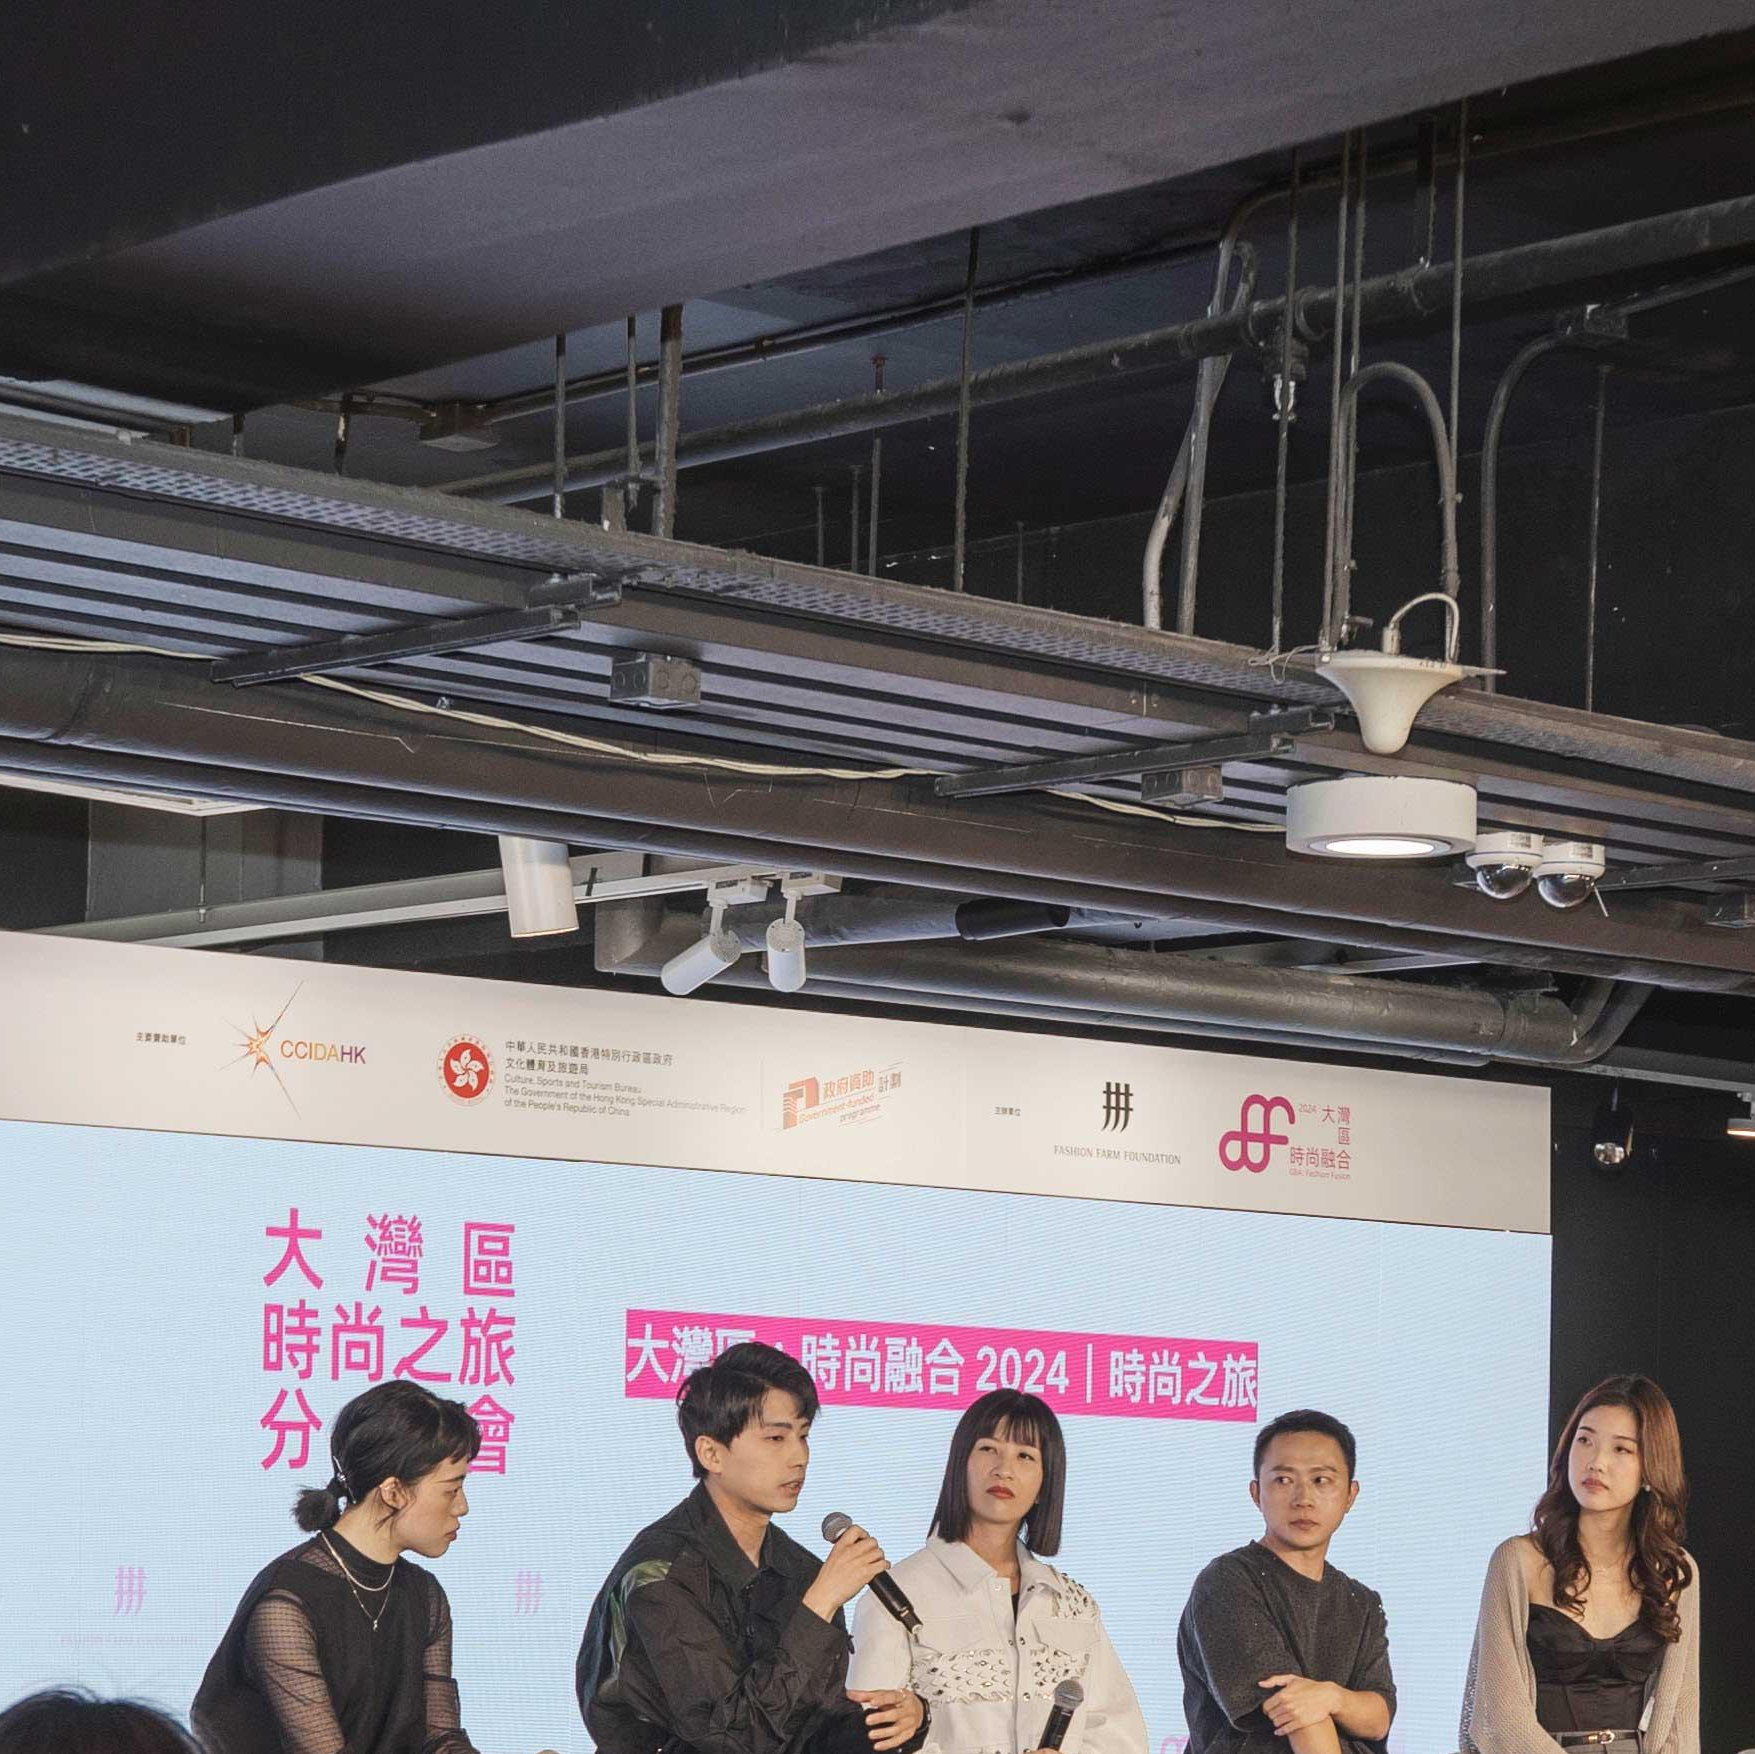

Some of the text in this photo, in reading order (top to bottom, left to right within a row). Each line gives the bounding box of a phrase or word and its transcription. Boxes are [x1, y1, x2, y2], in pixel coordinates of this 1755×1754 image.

[280, 1039, 366, 1064] CCIDAHK
[505, 1040, 673, 1066] 中華人民共和國香港特別行政區政府
[505, 1058, 589, 1076] 文化體育及旅遊局
[537, 1076, 563, 1089] Sports
[565, 1079, 580, 1088] and
[582, 1080, 613, 1091] Tourism
[823, 1069, 875, 1100] 政府資助
[504, 1098, 630, 1117] of the People's Republic of China
[505, 1086, 520, 1096] The
[520, 1087, 568, 1100] Government
[569, 1091, 579, 1100] of
[579, 1092, 592, 1102] the
[593, 1094, 615, 1106] Hong
[616, 1096, 636, 1108] Kong
[1054, 1144, 1182, 1165] FASHION FARM FOUNDATION
[1289, 1145, 1352, 1170] 時尚融合
[262, 1299, 516, 1387] 時尚之旅
[975, 1344, 1070, 1394] 2024
